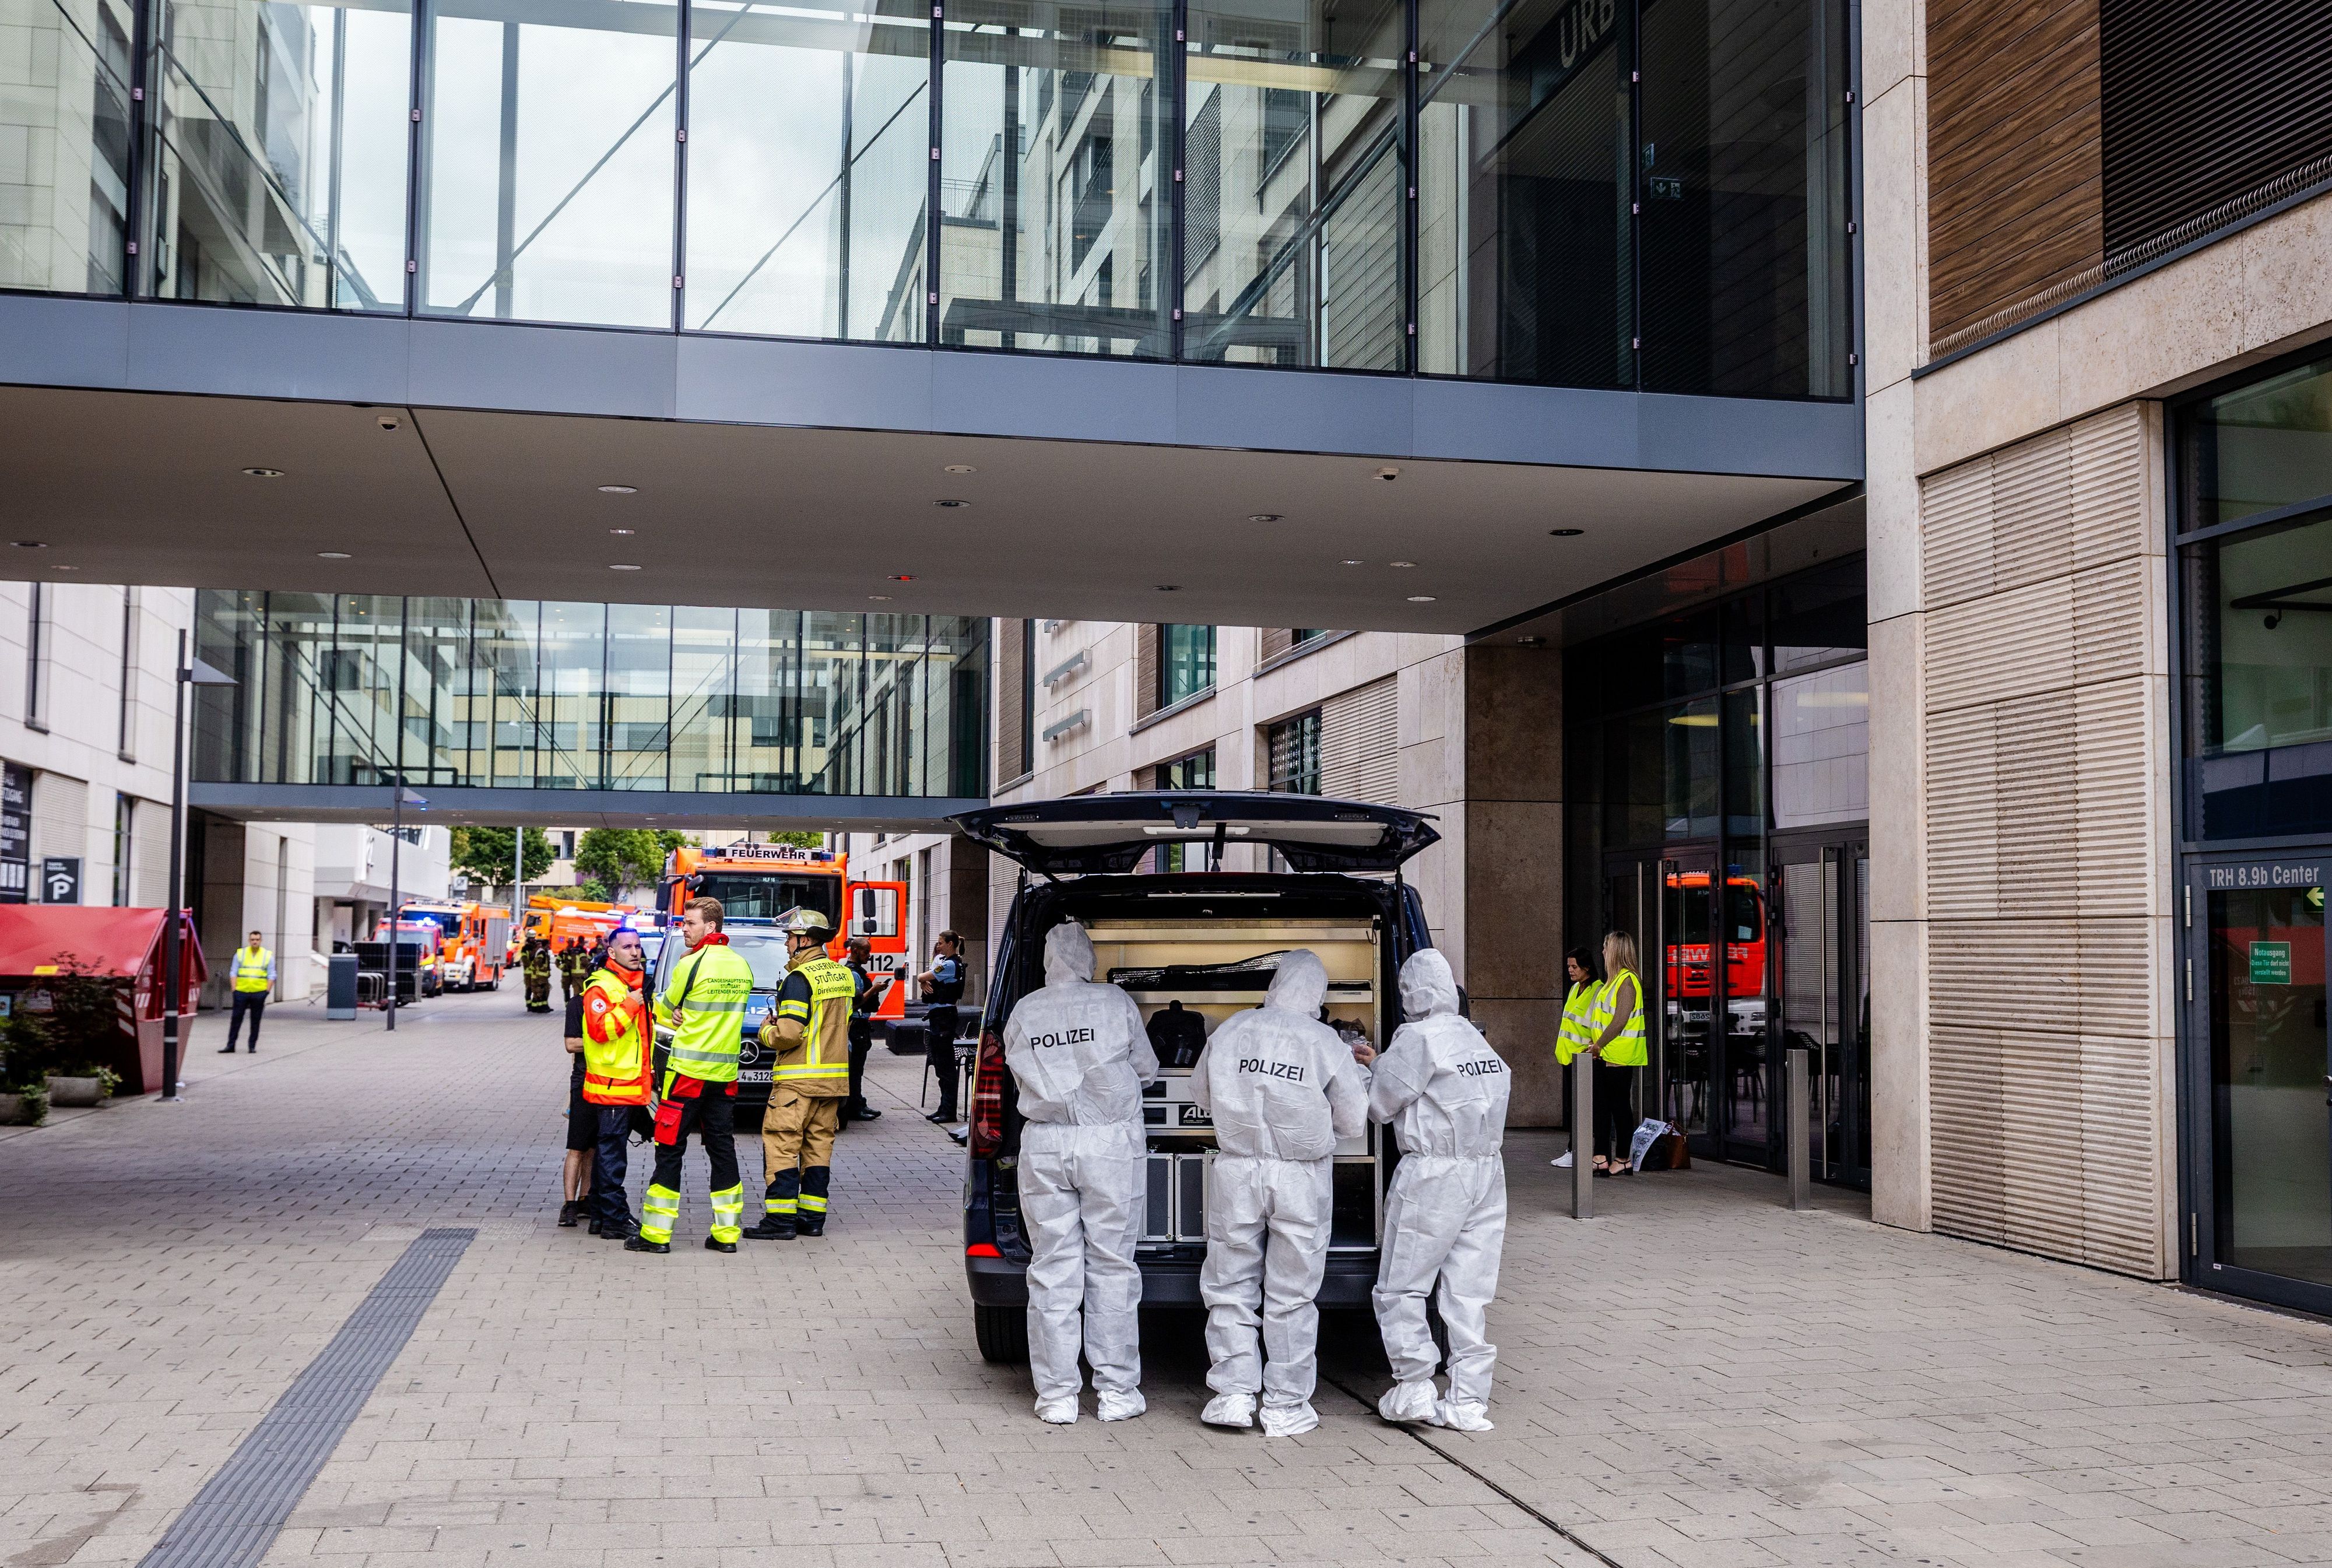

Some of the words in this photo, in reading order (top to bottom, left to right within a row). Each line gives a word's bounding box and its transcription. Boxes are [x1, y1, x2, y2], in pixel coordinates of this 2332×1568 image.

[732, 849, 806, 859] FEUERWEHR
[2210, 869, 2233, 887] TRH
[2238, 867, 2268, 886] 8.9b
[2273, 866, 2319, 884] Center
[2254, 948, 2285, 958] Notausgang
[868, 955, 893, 971] 112
[814, 973, 849, 985] STUTTGART
[817, 985, 852, 995] Direktionsdienst
[1030, 1028, 1094, 1050] POLIZEI
[741, 1071, 747, 1081] 4
[1239, 1059, 1304, 1081] POLIZEI
